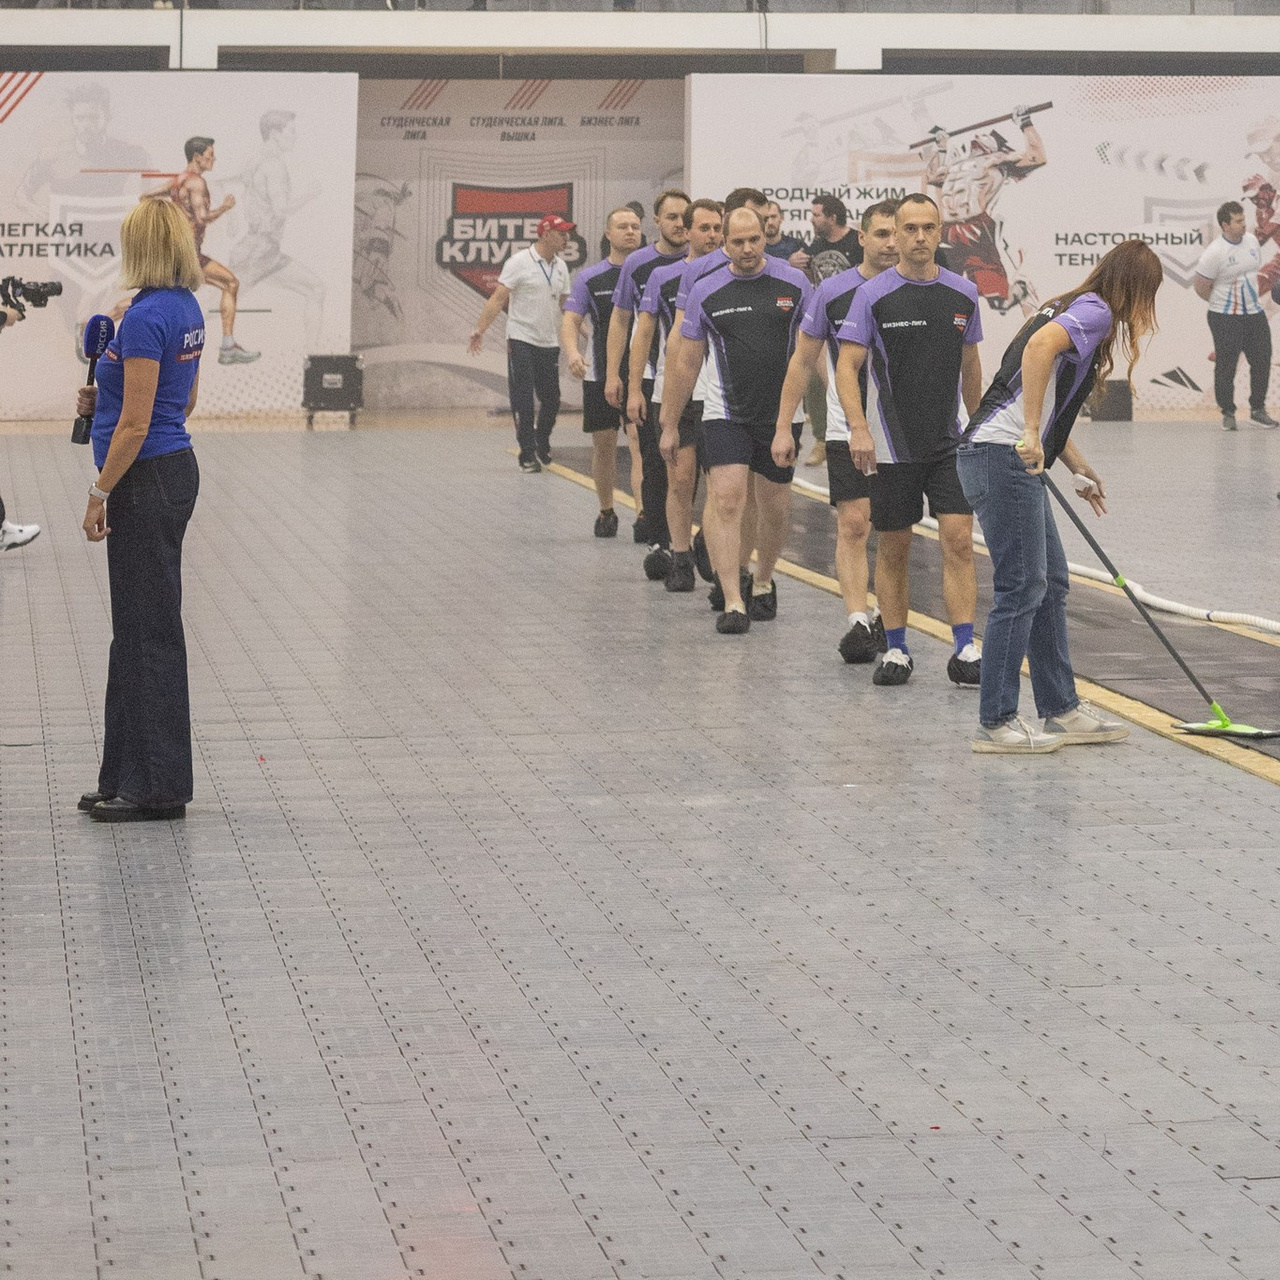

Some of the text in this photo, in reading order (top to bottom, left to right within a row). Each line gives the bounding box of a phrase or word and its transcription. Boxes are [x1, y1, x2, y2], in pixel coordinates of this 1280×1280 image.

[380, 116, 450, 129] СТУДЕНЧЕСКАЯ
[469, 116, 539, 129] СТУДЕНЧЕСКАЯ
[403, 130, 427, 141] ЛИГА
[763, 183, 906, 202] РОДНЫЙ ЖИМ
[882, 320, 928, 329] БИЗНЕС-ЛИГА
[96, 320, 108, 355] РОССИЯ
